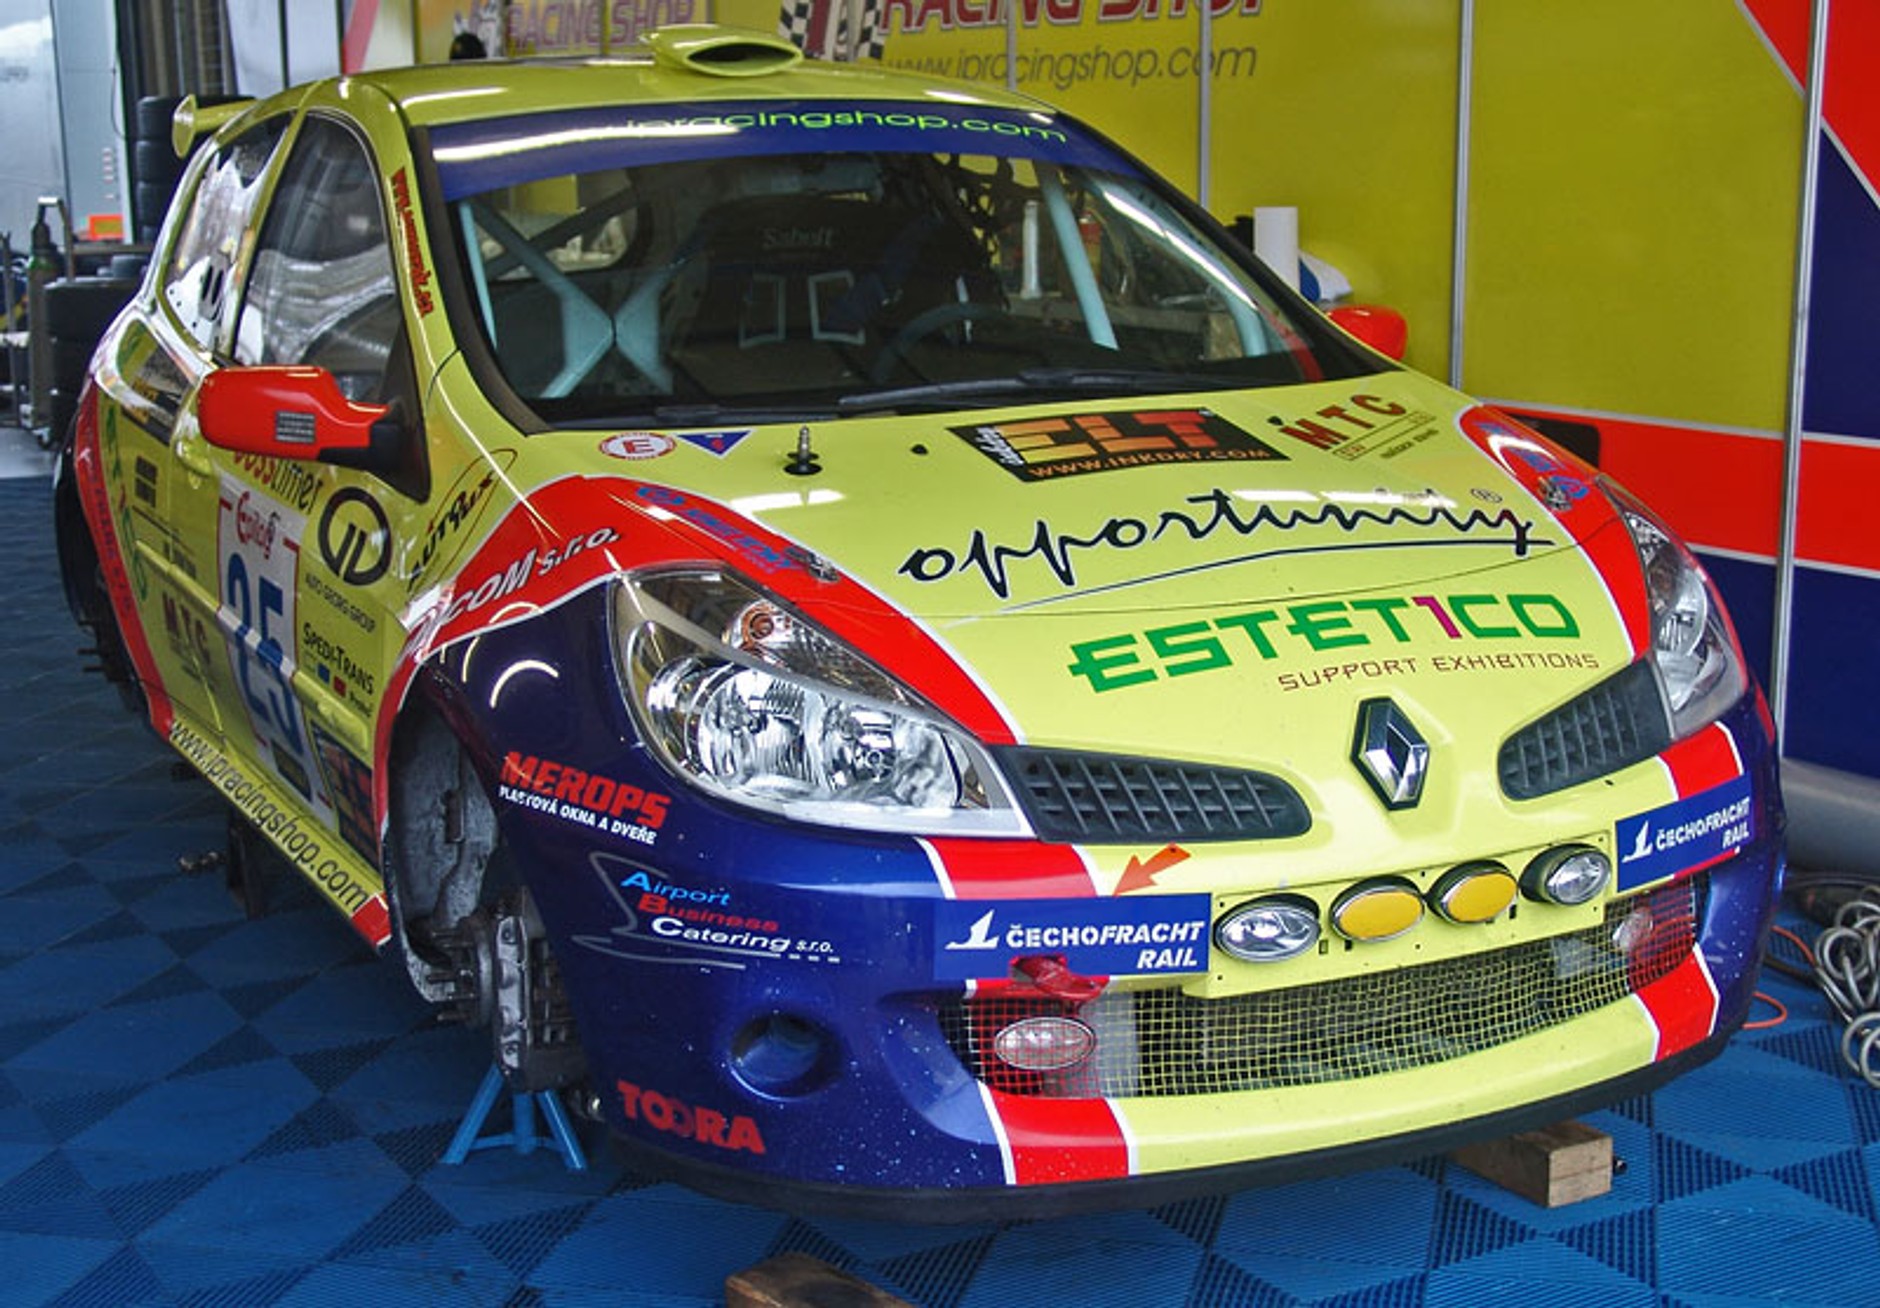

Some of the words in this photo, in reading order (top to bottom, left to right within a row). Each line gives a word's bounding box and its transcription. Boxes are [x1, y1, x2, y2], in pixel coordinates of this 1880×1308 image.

[898, 487, 1534, 599] opportunity
[1278, 657, 1418, 692] SUPPORT
[1432, 652, 1600, 672] EXHIBITIONS
[501, 752, 672, 830] MEROPS
[171, 721, 369, 912] www.ipracingshop.com
[560, 804, 597, 828] OKNA
[598, 815, 609, 831] A
[611, 819, 658, 846] DVEŘE
[1655, 796, 1751, 851] ČECHOFRACHT
[1721, 822, 1750, 850] RAIL
[619, 870, 731, 906] Airport
[637, 894, 780, 932] Business
[652, 916, 791, 953] Catering
[796, 939, 835, 953] s.r.o.
[1005, 921, 1206, 949] ČECHOFRACHT
[1136, 949, 1198, 970] RAIL
[616, 1078, 767, 1155] TOORA
